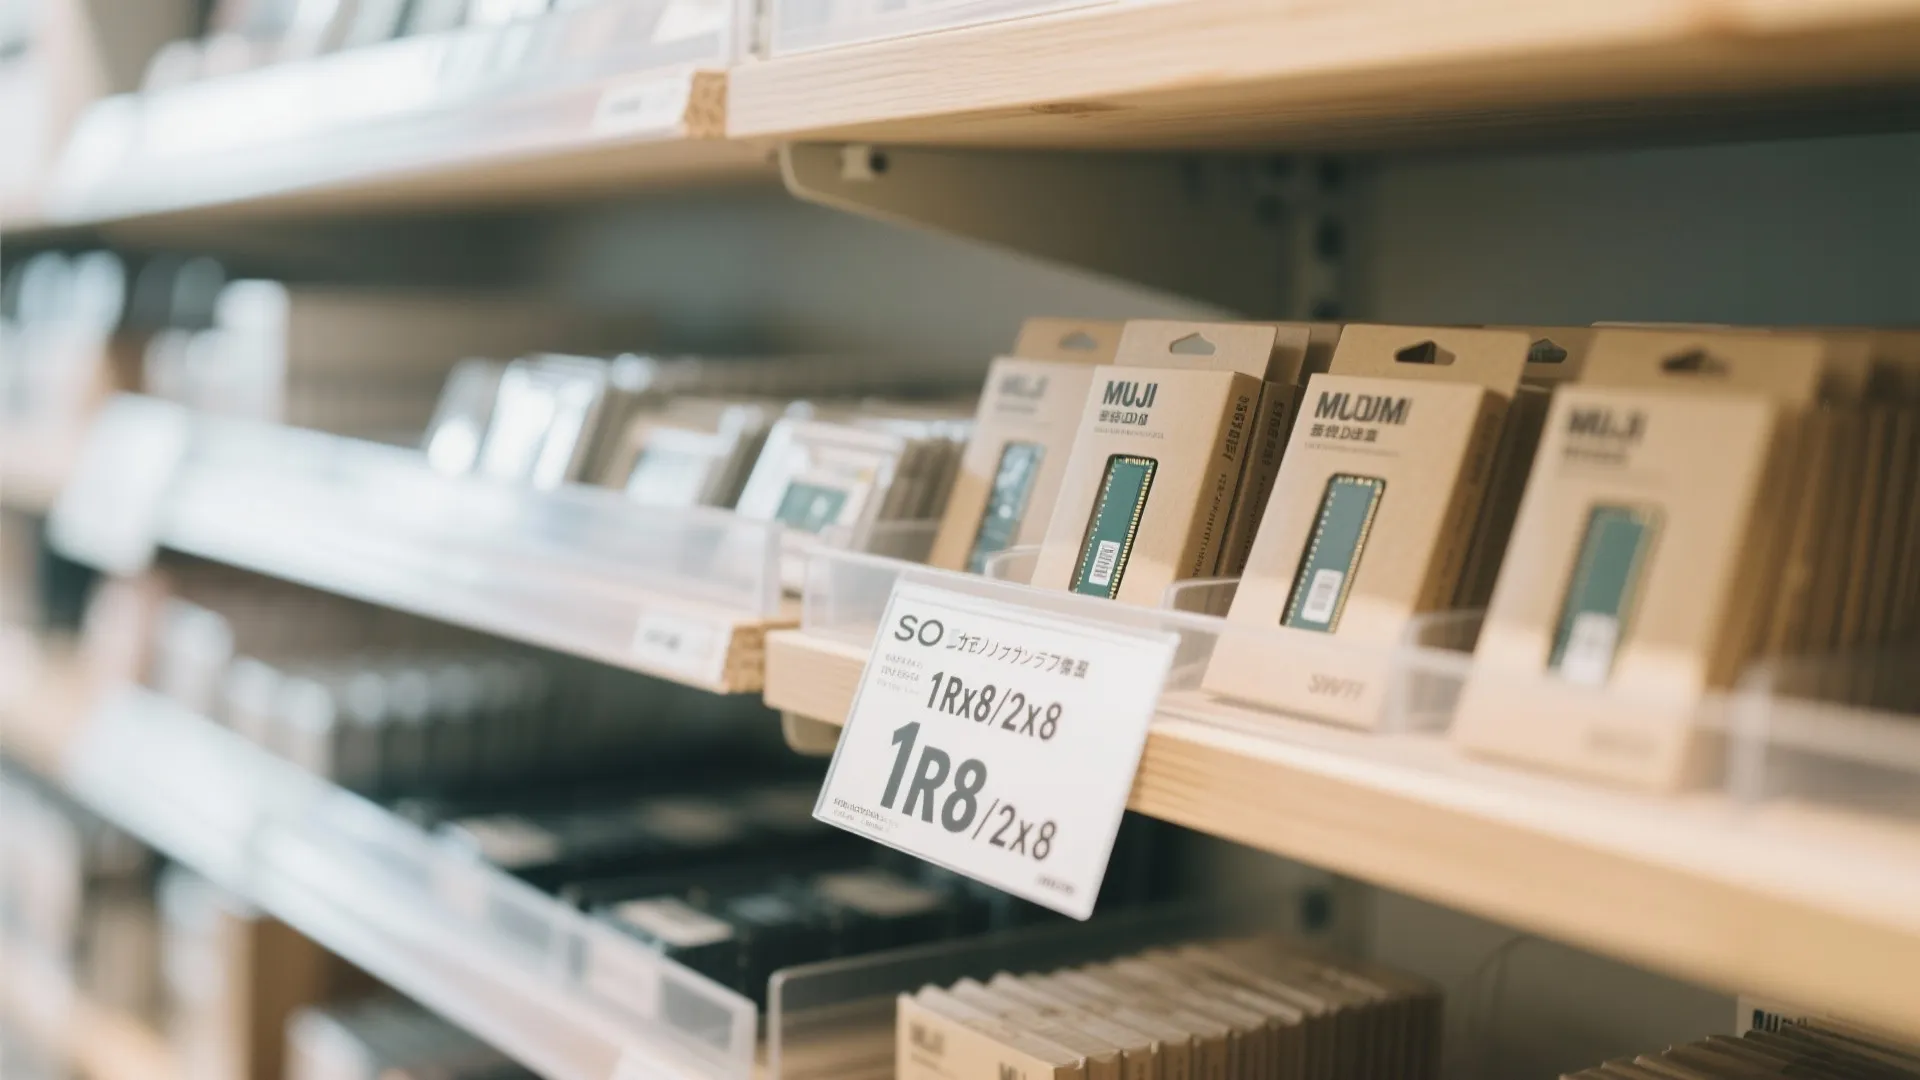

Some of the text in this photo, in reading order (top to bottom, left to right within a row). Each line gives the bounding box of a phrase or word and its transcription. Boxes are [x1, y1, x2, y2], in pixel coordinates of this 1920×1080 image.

[1103, 381, 1159, 409] MUJI
[894, 614, 945, 648] SO
[926, 671, 1063, 742] 1Rx8/2x8
